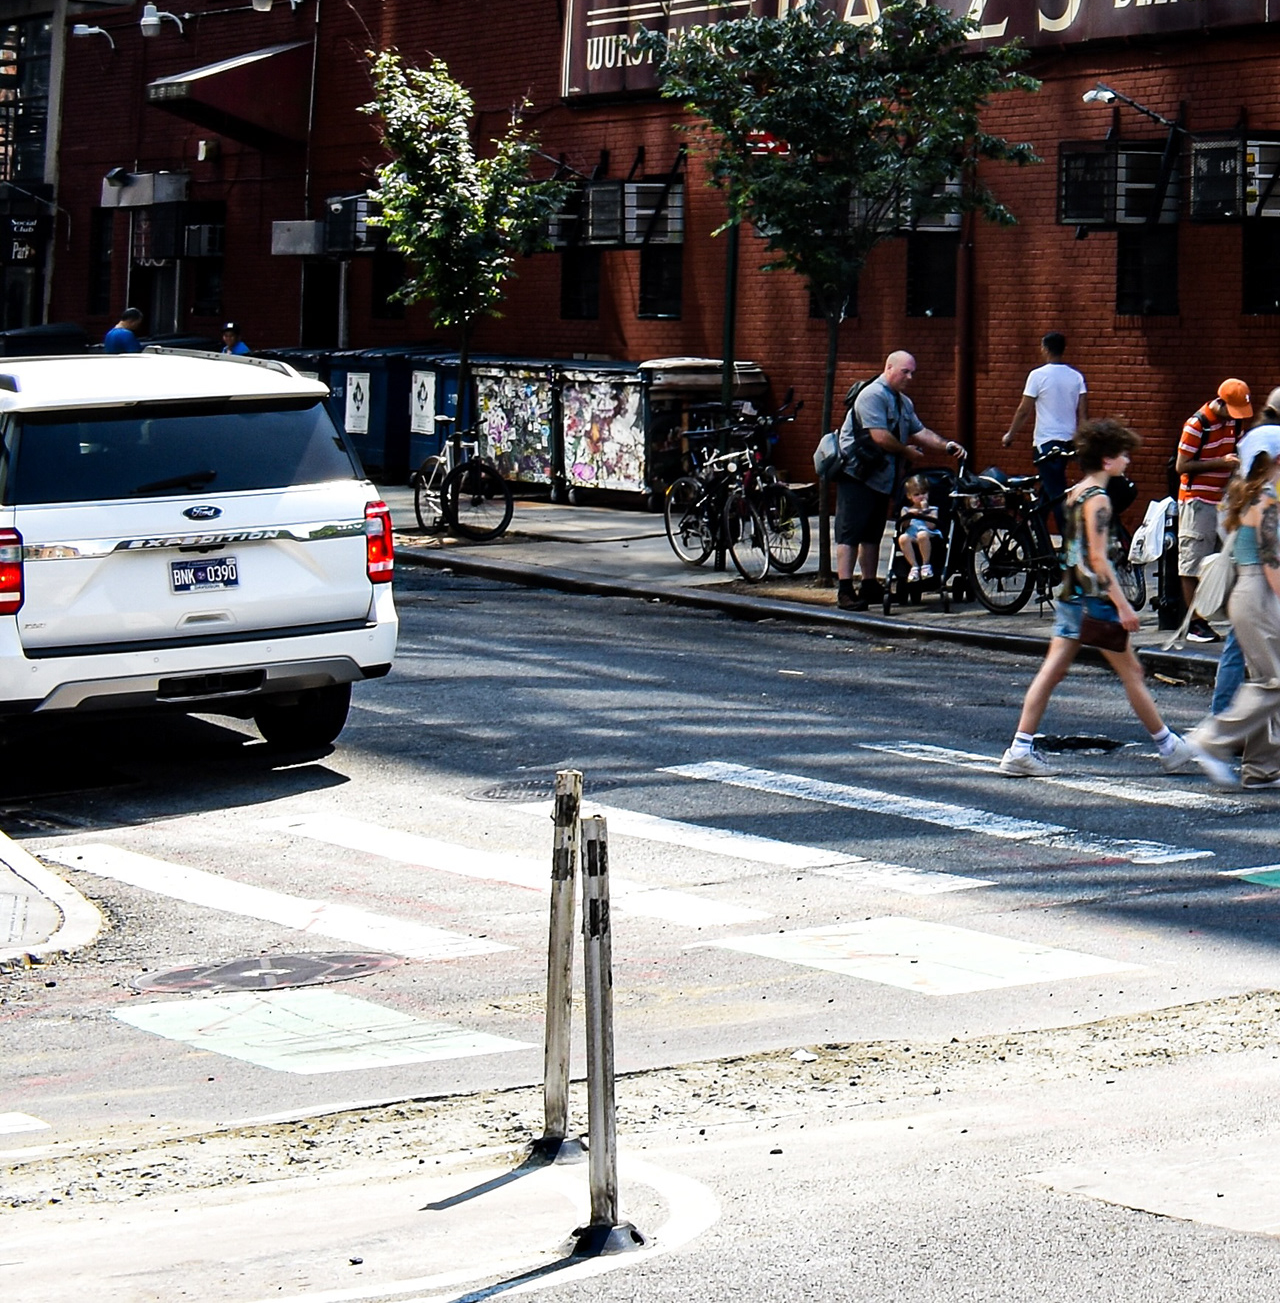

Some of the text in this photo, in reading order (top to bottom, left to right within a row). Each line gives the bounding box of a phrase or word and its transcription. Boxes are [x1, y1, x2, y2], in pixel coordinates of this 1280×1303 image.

[191, 506, 215, 517] Ford
[129, 530, 280, 548] EXPEDITION
[173, 565, 237, 585] BNK 0390
